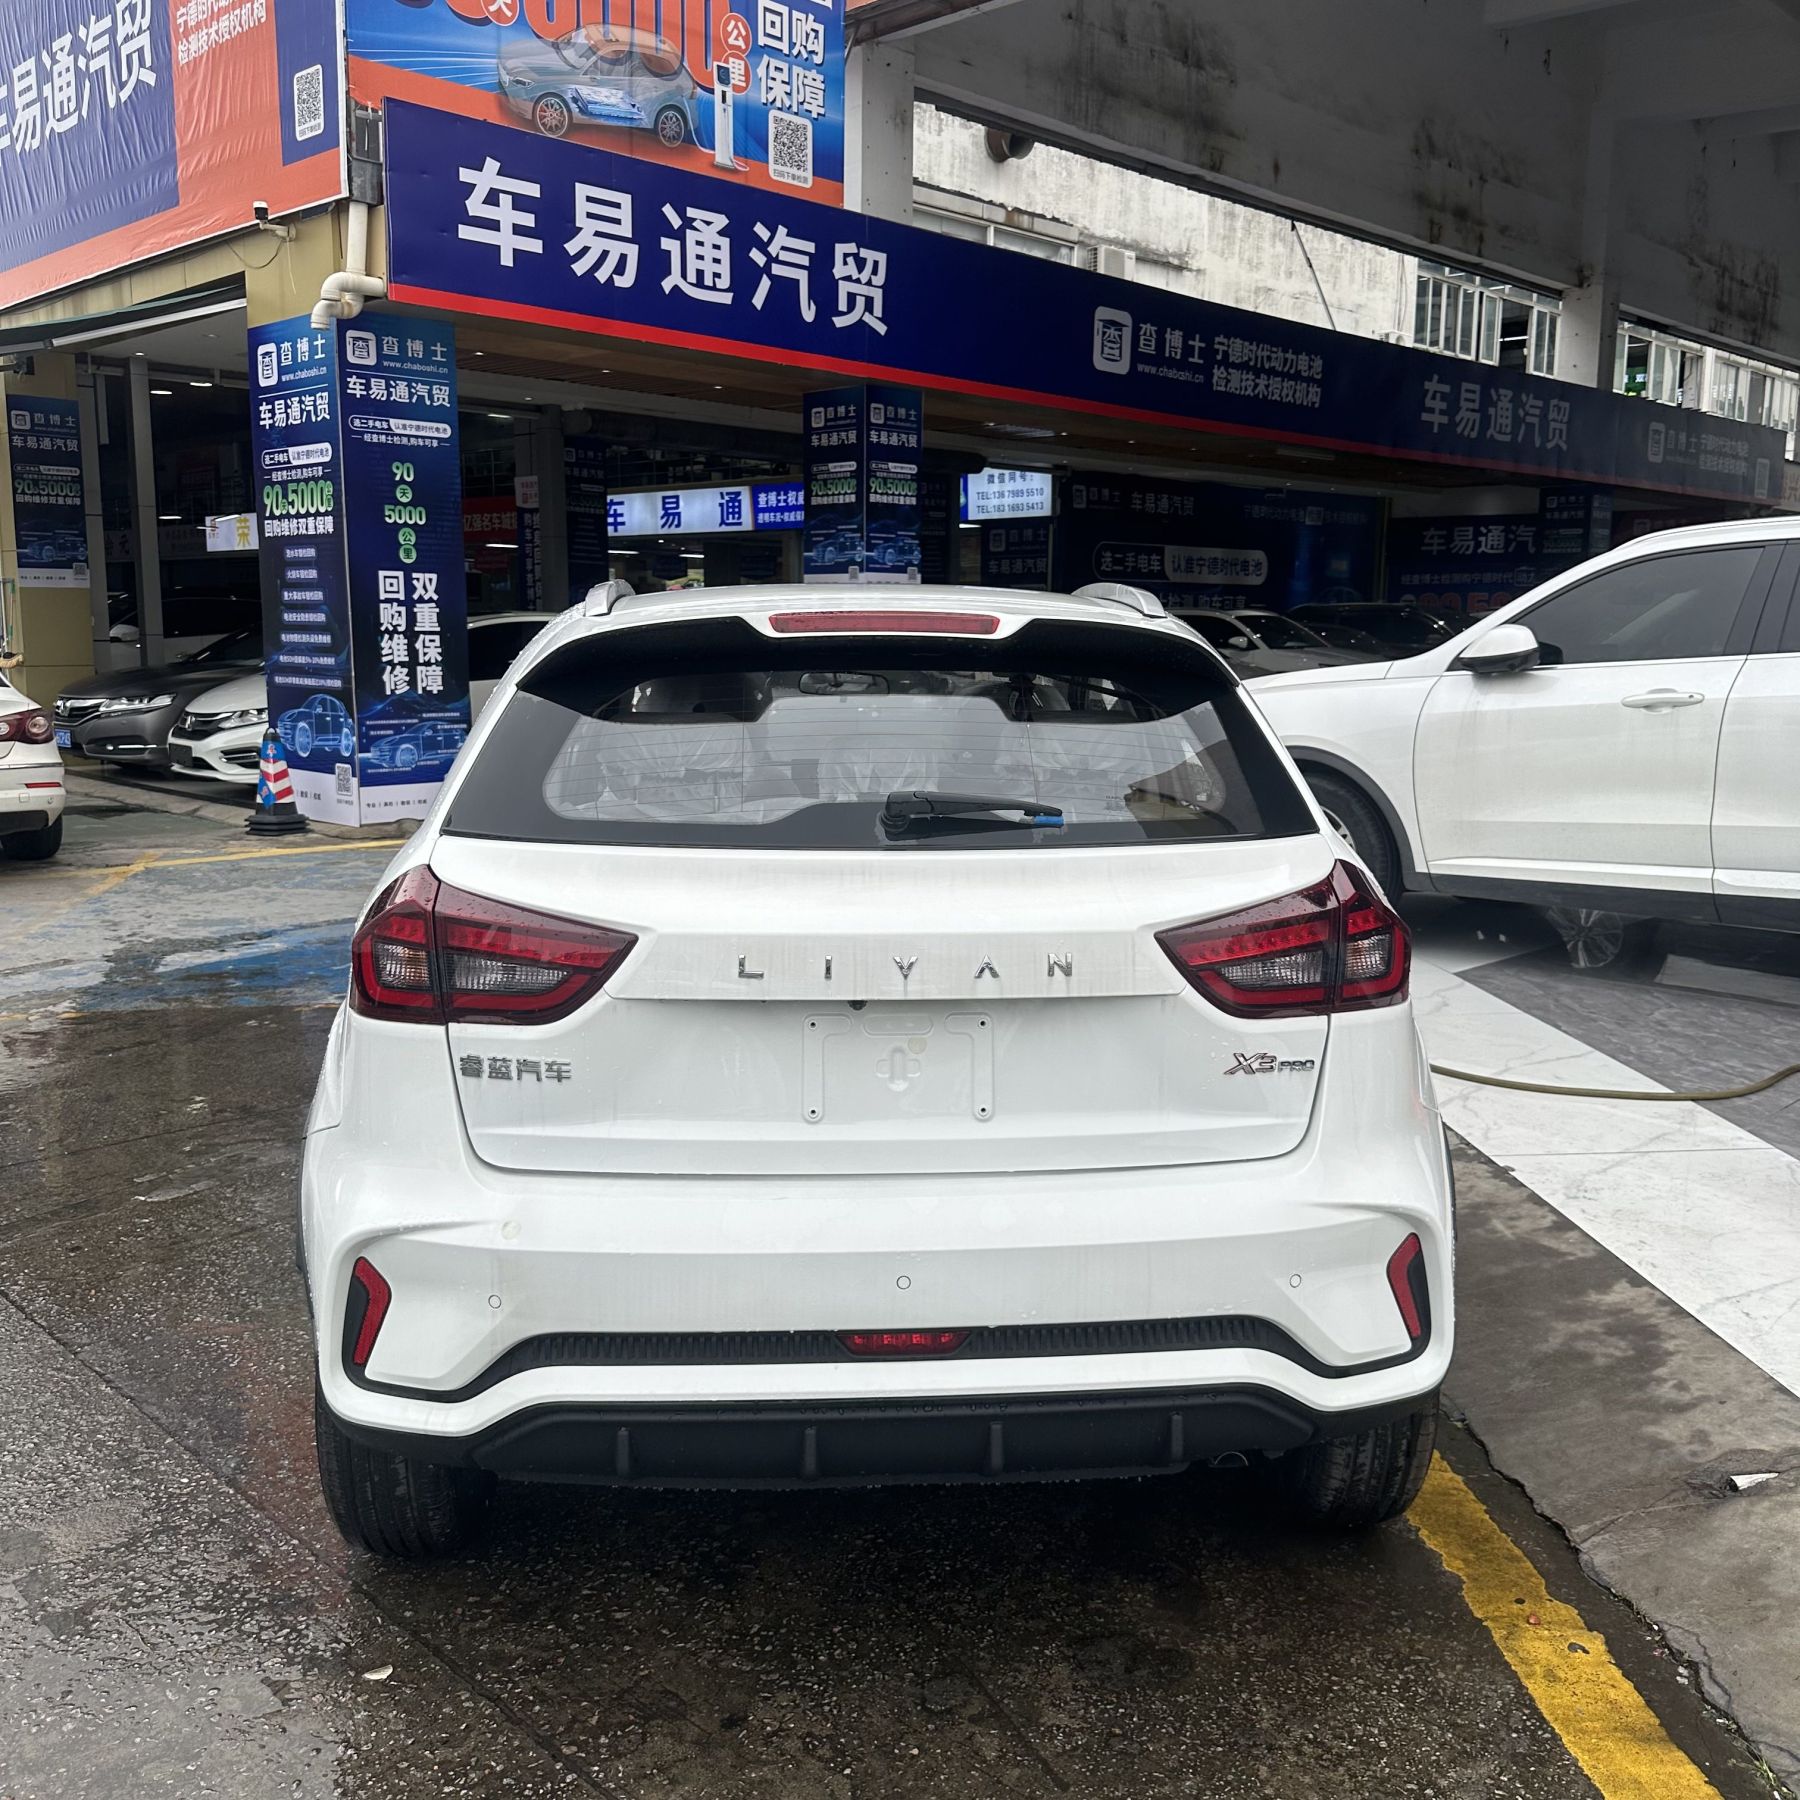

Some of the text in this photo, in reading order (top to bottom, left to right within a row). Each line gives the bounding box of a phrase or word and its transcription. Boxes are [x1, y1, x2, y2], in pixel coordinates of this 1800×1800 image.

[758, 0, 826, 65] 回购
[0, 0, 157, 157] 易通汽贸
[757, 55, 826, 120] 保障
[457, 156, 888, 337] 车易通汽贸
[281, 333, 326, 367] 查博士
[382, 336, 447, 362] 查博士
[1138, 322, 1206, 365] 查博士
[1213, 334, 1323, 380] 宁德时代动力电池
[382, 360, 449, 374] www.chaboshi.cn
[346, 375, 451, 408] 车易通汽贸
[1212, 364, 1321, 409] 检测技术授权机构
[259, 391, 331, 430] 车易通汽贸
[1420, 373, 1571, 452] 车易通汽贸
[11, 434, 80, 453] 车易通汽贸
[869, 429, 918, 448] 车易通汽贸
[391, 461, 415, 482] 90
[384, 504, 427, 525] 5000
[607, 491, 743, 533] 车易通
[1129, 490, 1195, 517] 车易通汽贸
[264, 516, 334, 538] 回购维修双重保障
[1100, 551, 1162, 574] 选二手电车
[1171, 553, 1264, 577] 认准宁德时代电池
[377, 570, 411, 695] 回购维修
[411, 572, 444, 694] 双重保障
[738, 952, 1073, 980] LIYAN
[1223, 1052, 1315, 1075] X3 PRO
